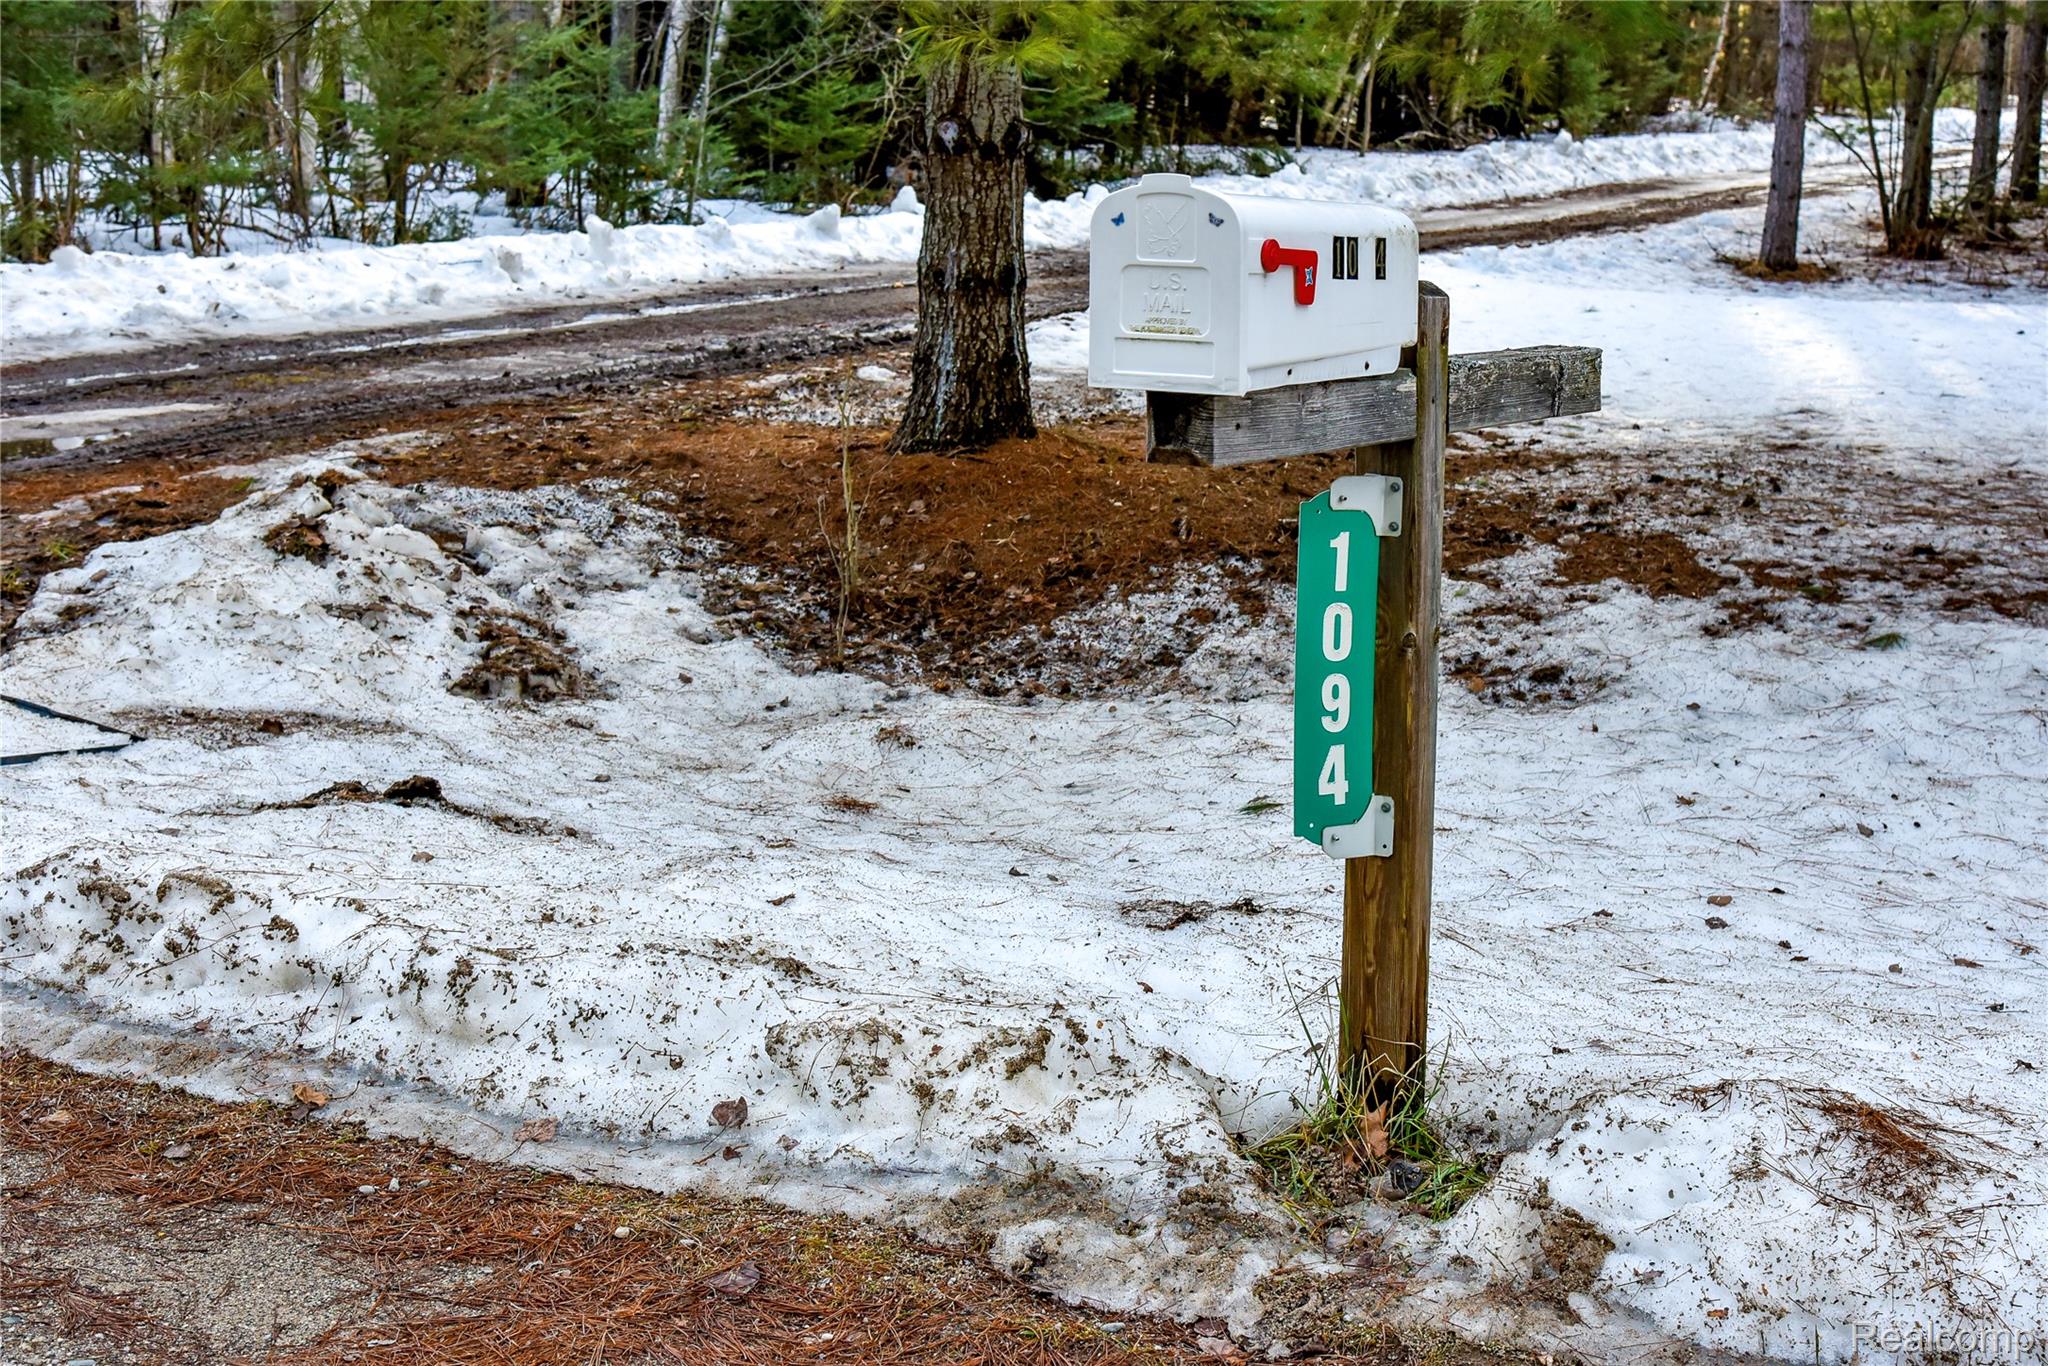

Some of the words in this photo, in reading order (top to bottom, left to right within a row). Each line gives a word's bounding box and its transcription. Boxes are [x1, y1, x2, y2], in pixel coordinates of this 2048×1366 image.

[1149, 273, 1187, 291] U.S.
[1143, 292, 1191, 314] MAIL
[1318, 531, 1354, 806] 1094
